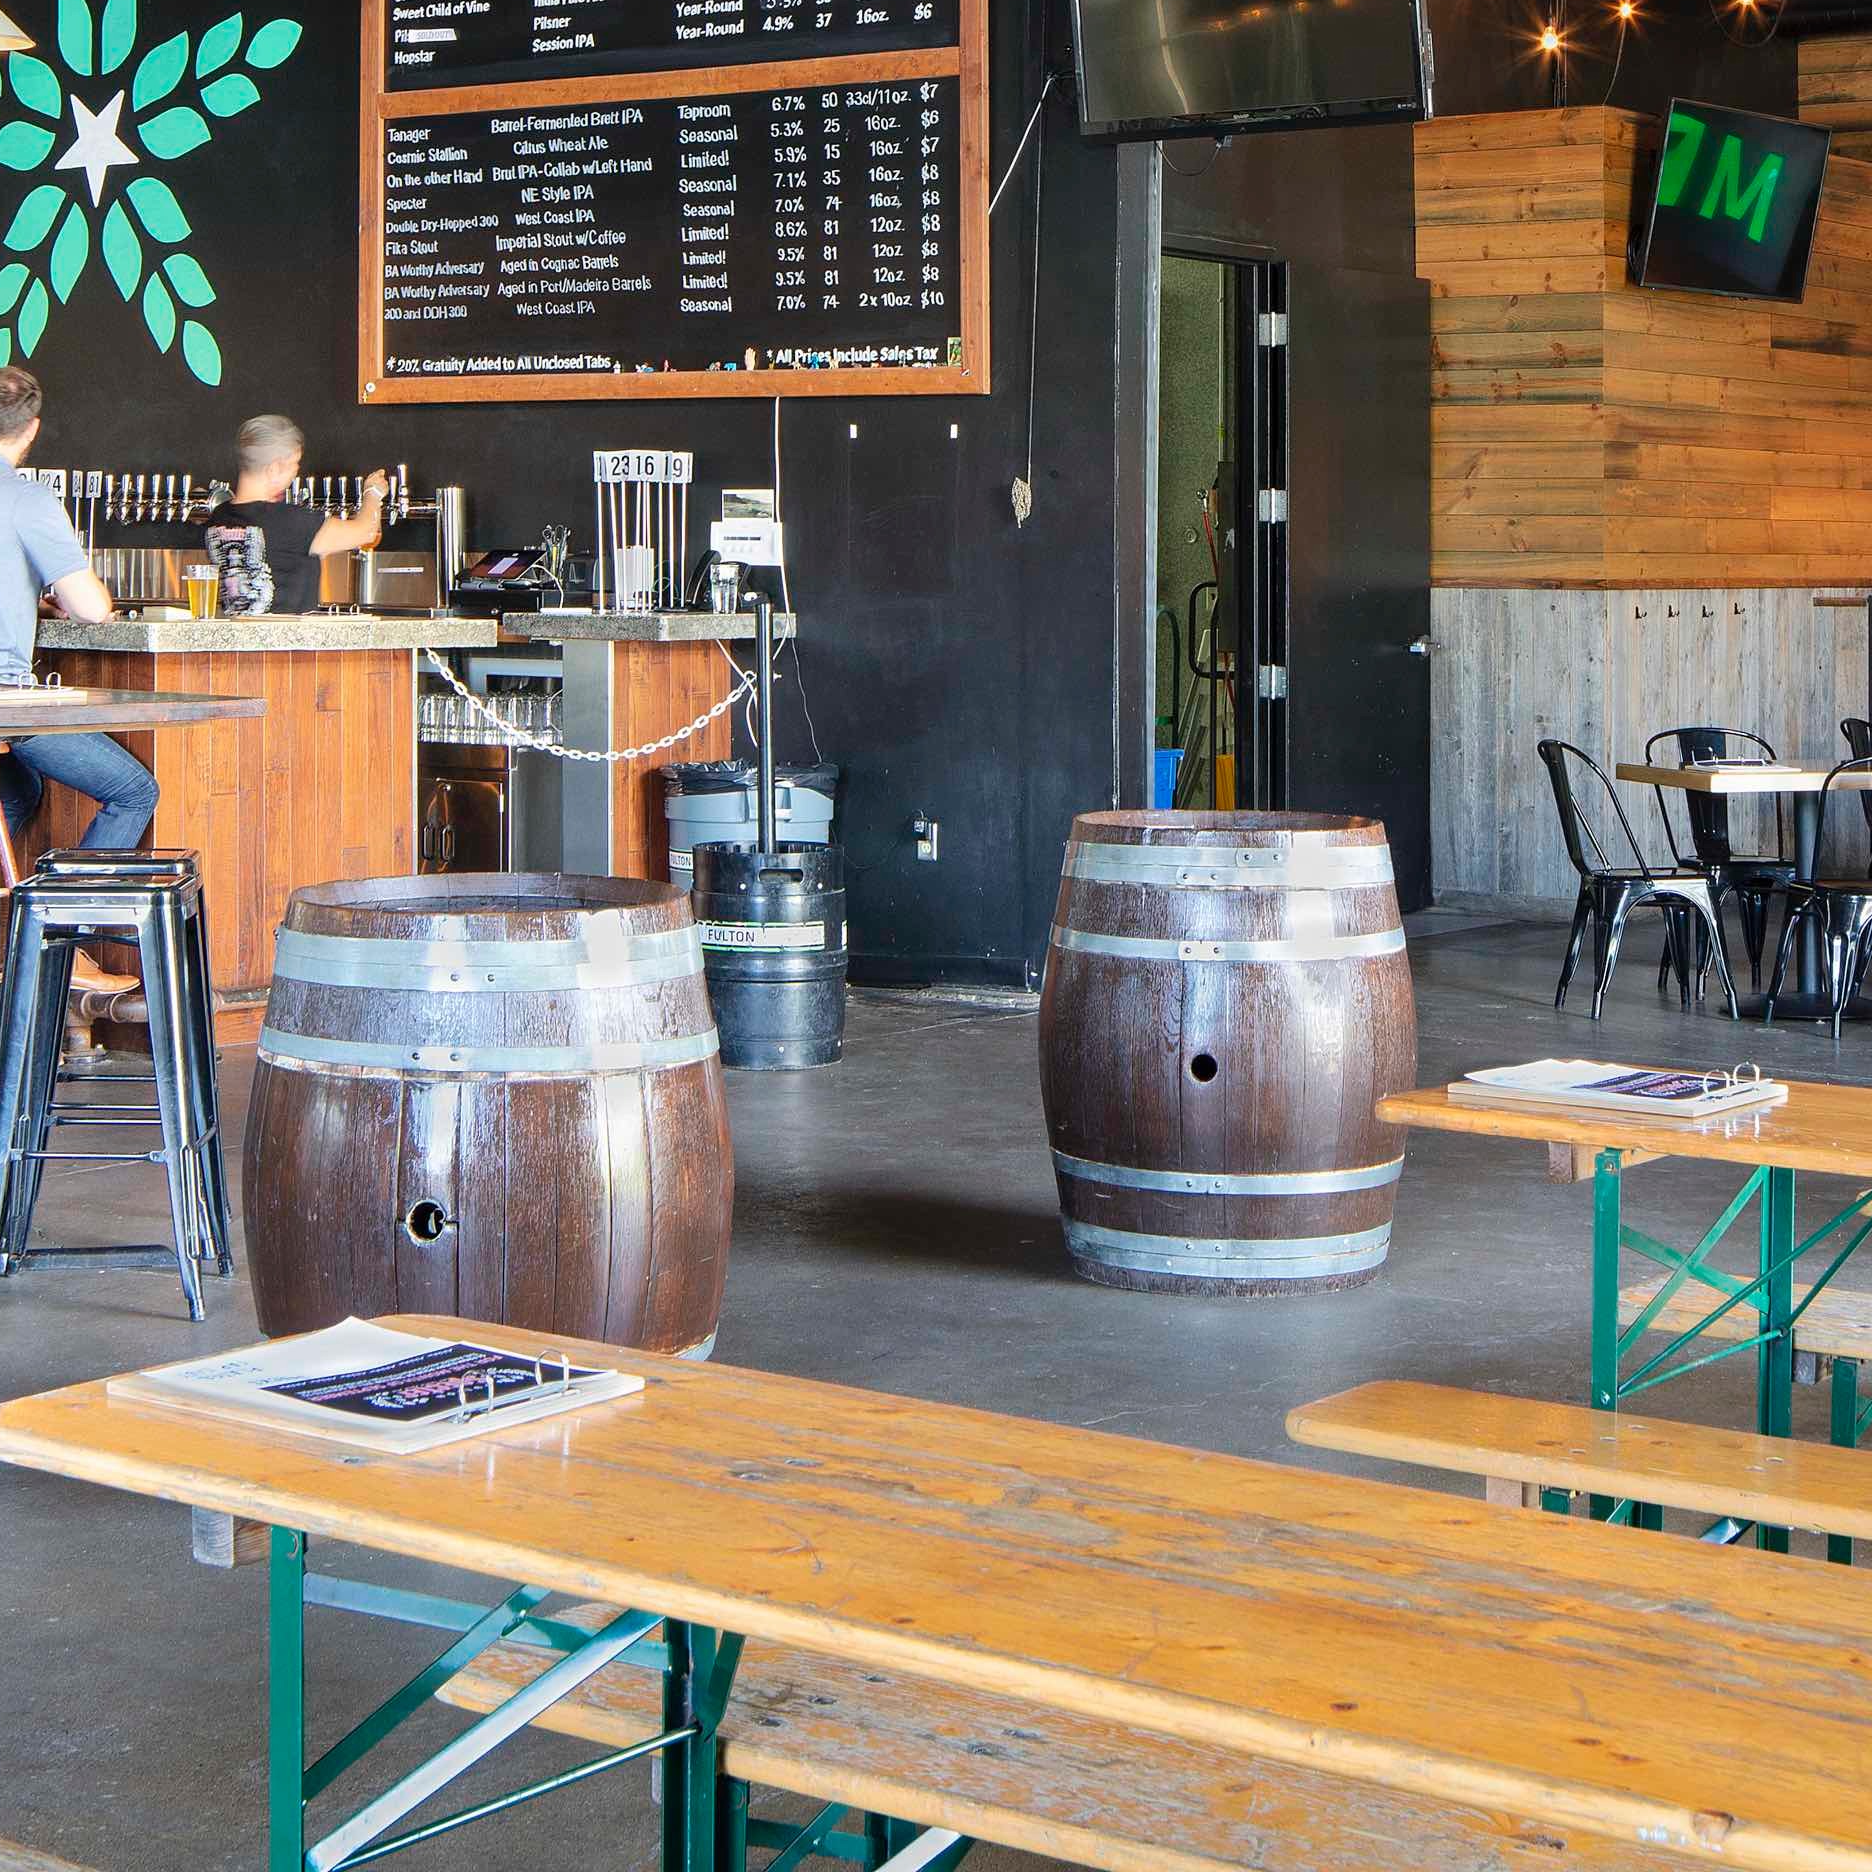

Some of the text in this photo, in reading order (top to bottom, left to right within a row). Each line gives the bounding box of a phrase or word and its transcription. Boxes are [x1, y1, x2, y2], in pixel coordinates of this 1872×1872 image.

[393, 7, 424, 21] Sweet
[426, 3, 451, 17] Child
[453, 1, 465, 14] of
[466, 0, 490, 14] Vine
[534, 16, 571, 30] Pilsner
[395, 3, 932, 64] Hopstar Session IPA Year-Round 16oz. $6
[387, 105, 731, 143] Tanager Barrel-Fermented Brett IPA Taproom
[387, 125, 738, 164] Cosmic Stallion Citrus Wheat Ale Seasonal
[387, 175, 402, 188] On
[404, 174, 422, 186] the
[424, 171, 452, 185] other
[454, 168, 482, 183] Hand
[518, 162, 580, 179] IPA-Collab
[582, 159, 618, 174] w/Left
[620, 158, 652, 172] Hand
[681, 150, 729, 168] Limited!
[387, 175, 736, 213] Specter NE Style IPA Seasonal
[386, 200, 734, 233] Double Dry-Hopped 300 West Coast IPA Seasonal
[386, 223, 729, 256] Fika Stout Imperial Stout w/Coffee Limited!
[396, 354, 611, 374] 20% Gratuity Added to All Unclosed Tabs
[775, 348, 793, 364] All
[833, 344, 879, 364] Include
[879, 344, 914, 362] Sales
[914, 344, 939, 361] Tax
[636, 455, 655, 476] 16
[707, 928, 755, 943] FULTON
